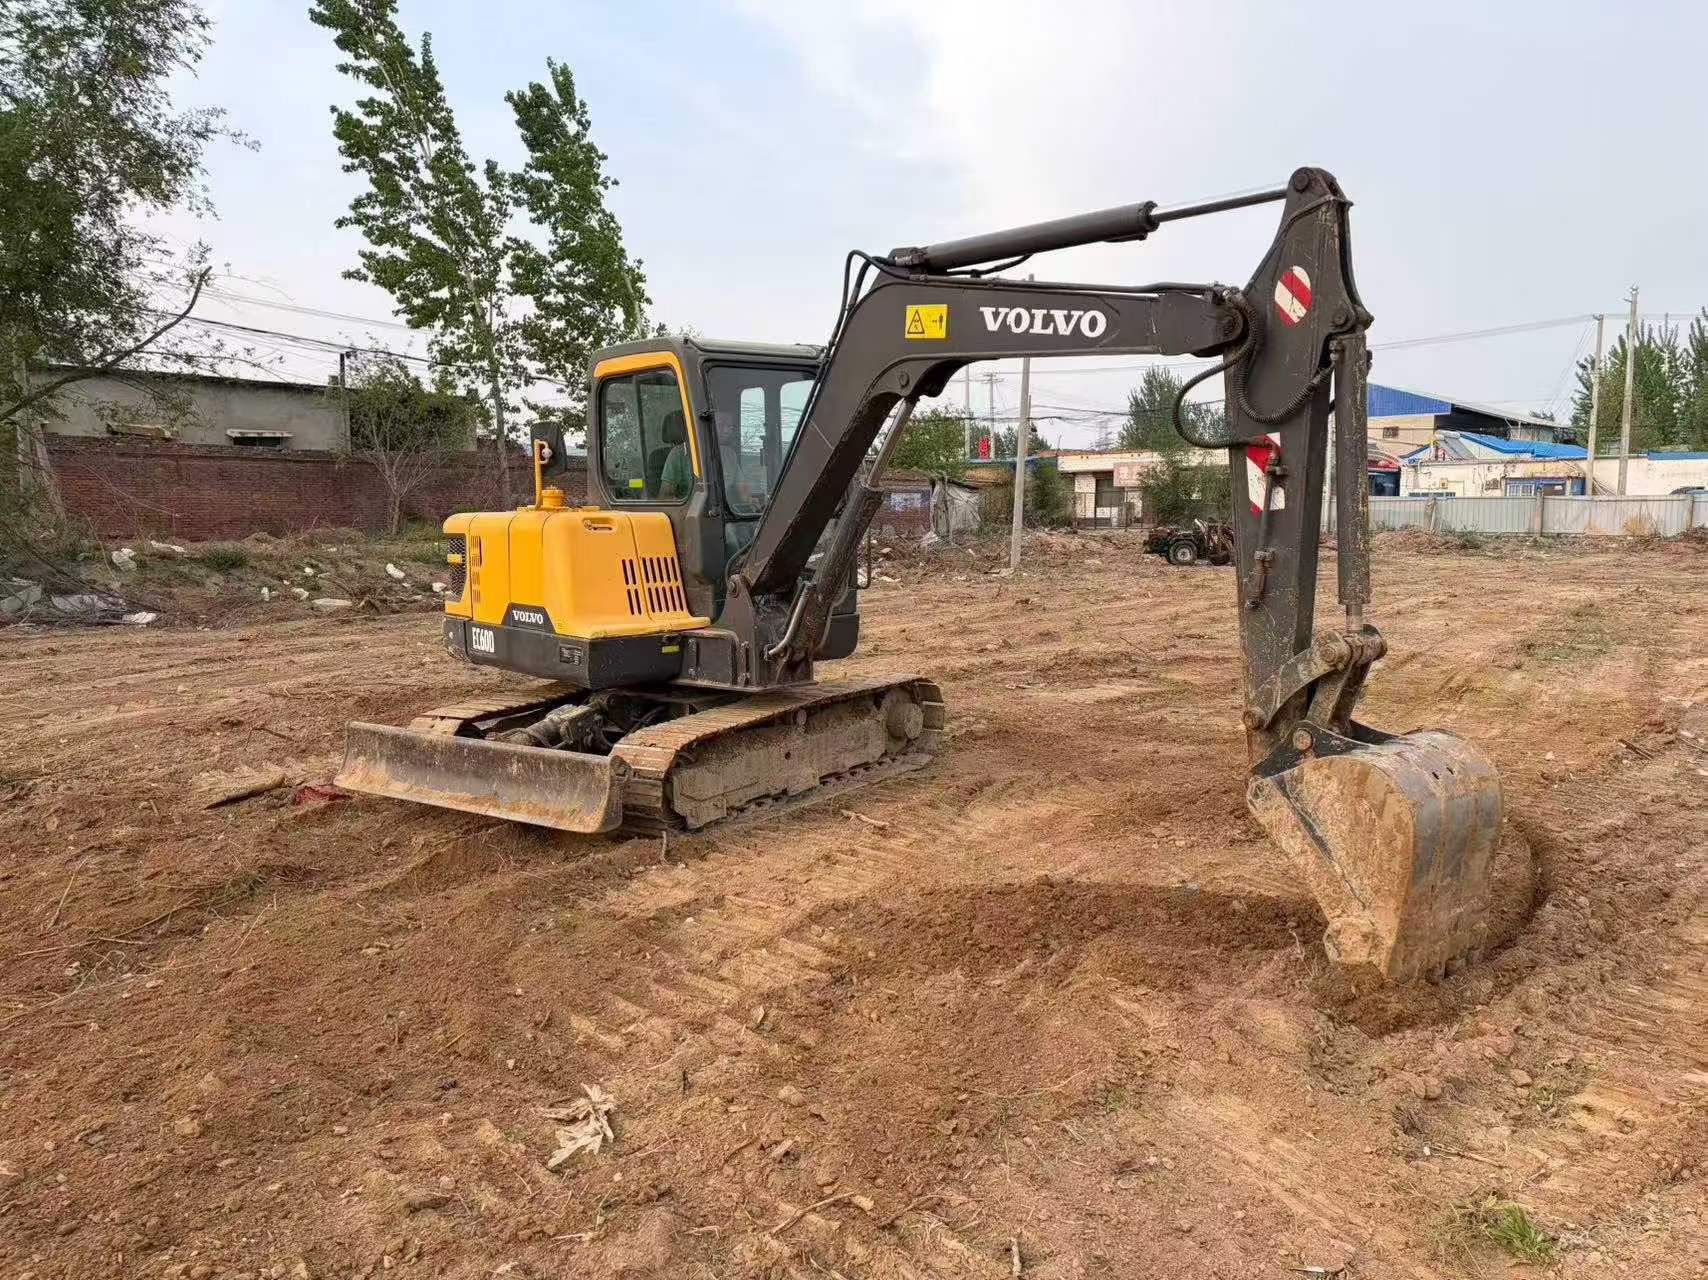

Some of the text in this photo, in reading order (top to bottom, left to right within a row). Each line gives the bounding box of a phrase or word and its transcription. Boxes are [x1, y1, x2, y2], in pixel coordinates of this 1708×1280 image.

[980, 306, 1107, 338] VOLVO
[512, 609, 544, 624] VOLVO
[471, 626, 495, 653] EC60D
